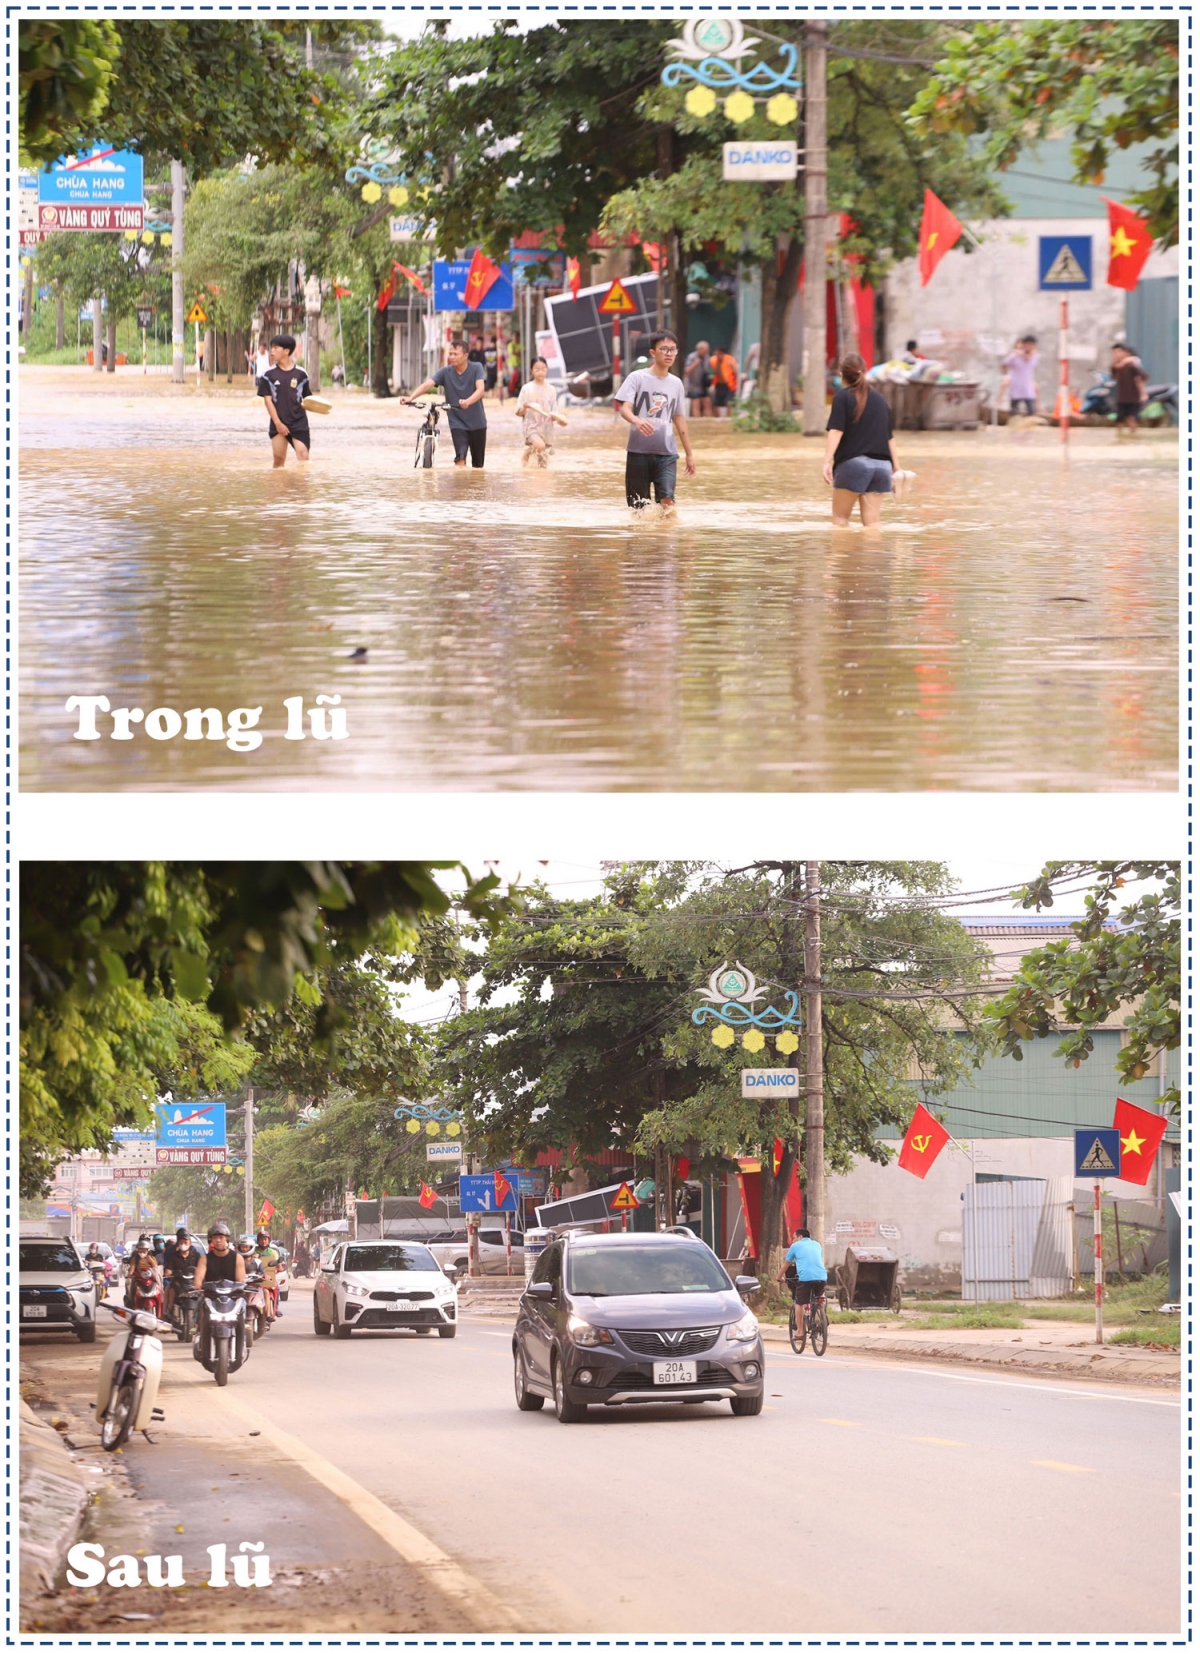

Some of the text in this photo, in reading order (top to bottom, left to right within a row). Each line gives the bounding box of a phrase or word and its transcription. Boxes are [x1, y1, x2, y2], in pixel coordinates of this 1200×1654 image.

[729, 150, 792, 165] DANKO
[92, 177, 125, 189] HANG
[92, 190, 112, 199] HANG
[59, 206, 87, 227] VÀNG
[91, 206, 111, 228] QUÝ
[745, 1074, 796, 1087] DANKO
[428, 1145, 460, 1154] DANKO
[169, 1149, 189, 1162] VÀNG
[190, 1149, 205, 1163] QUÝ
[665, 1362, 684, 1373] 20A
[658, 1372, 692, 1383] 601.43
